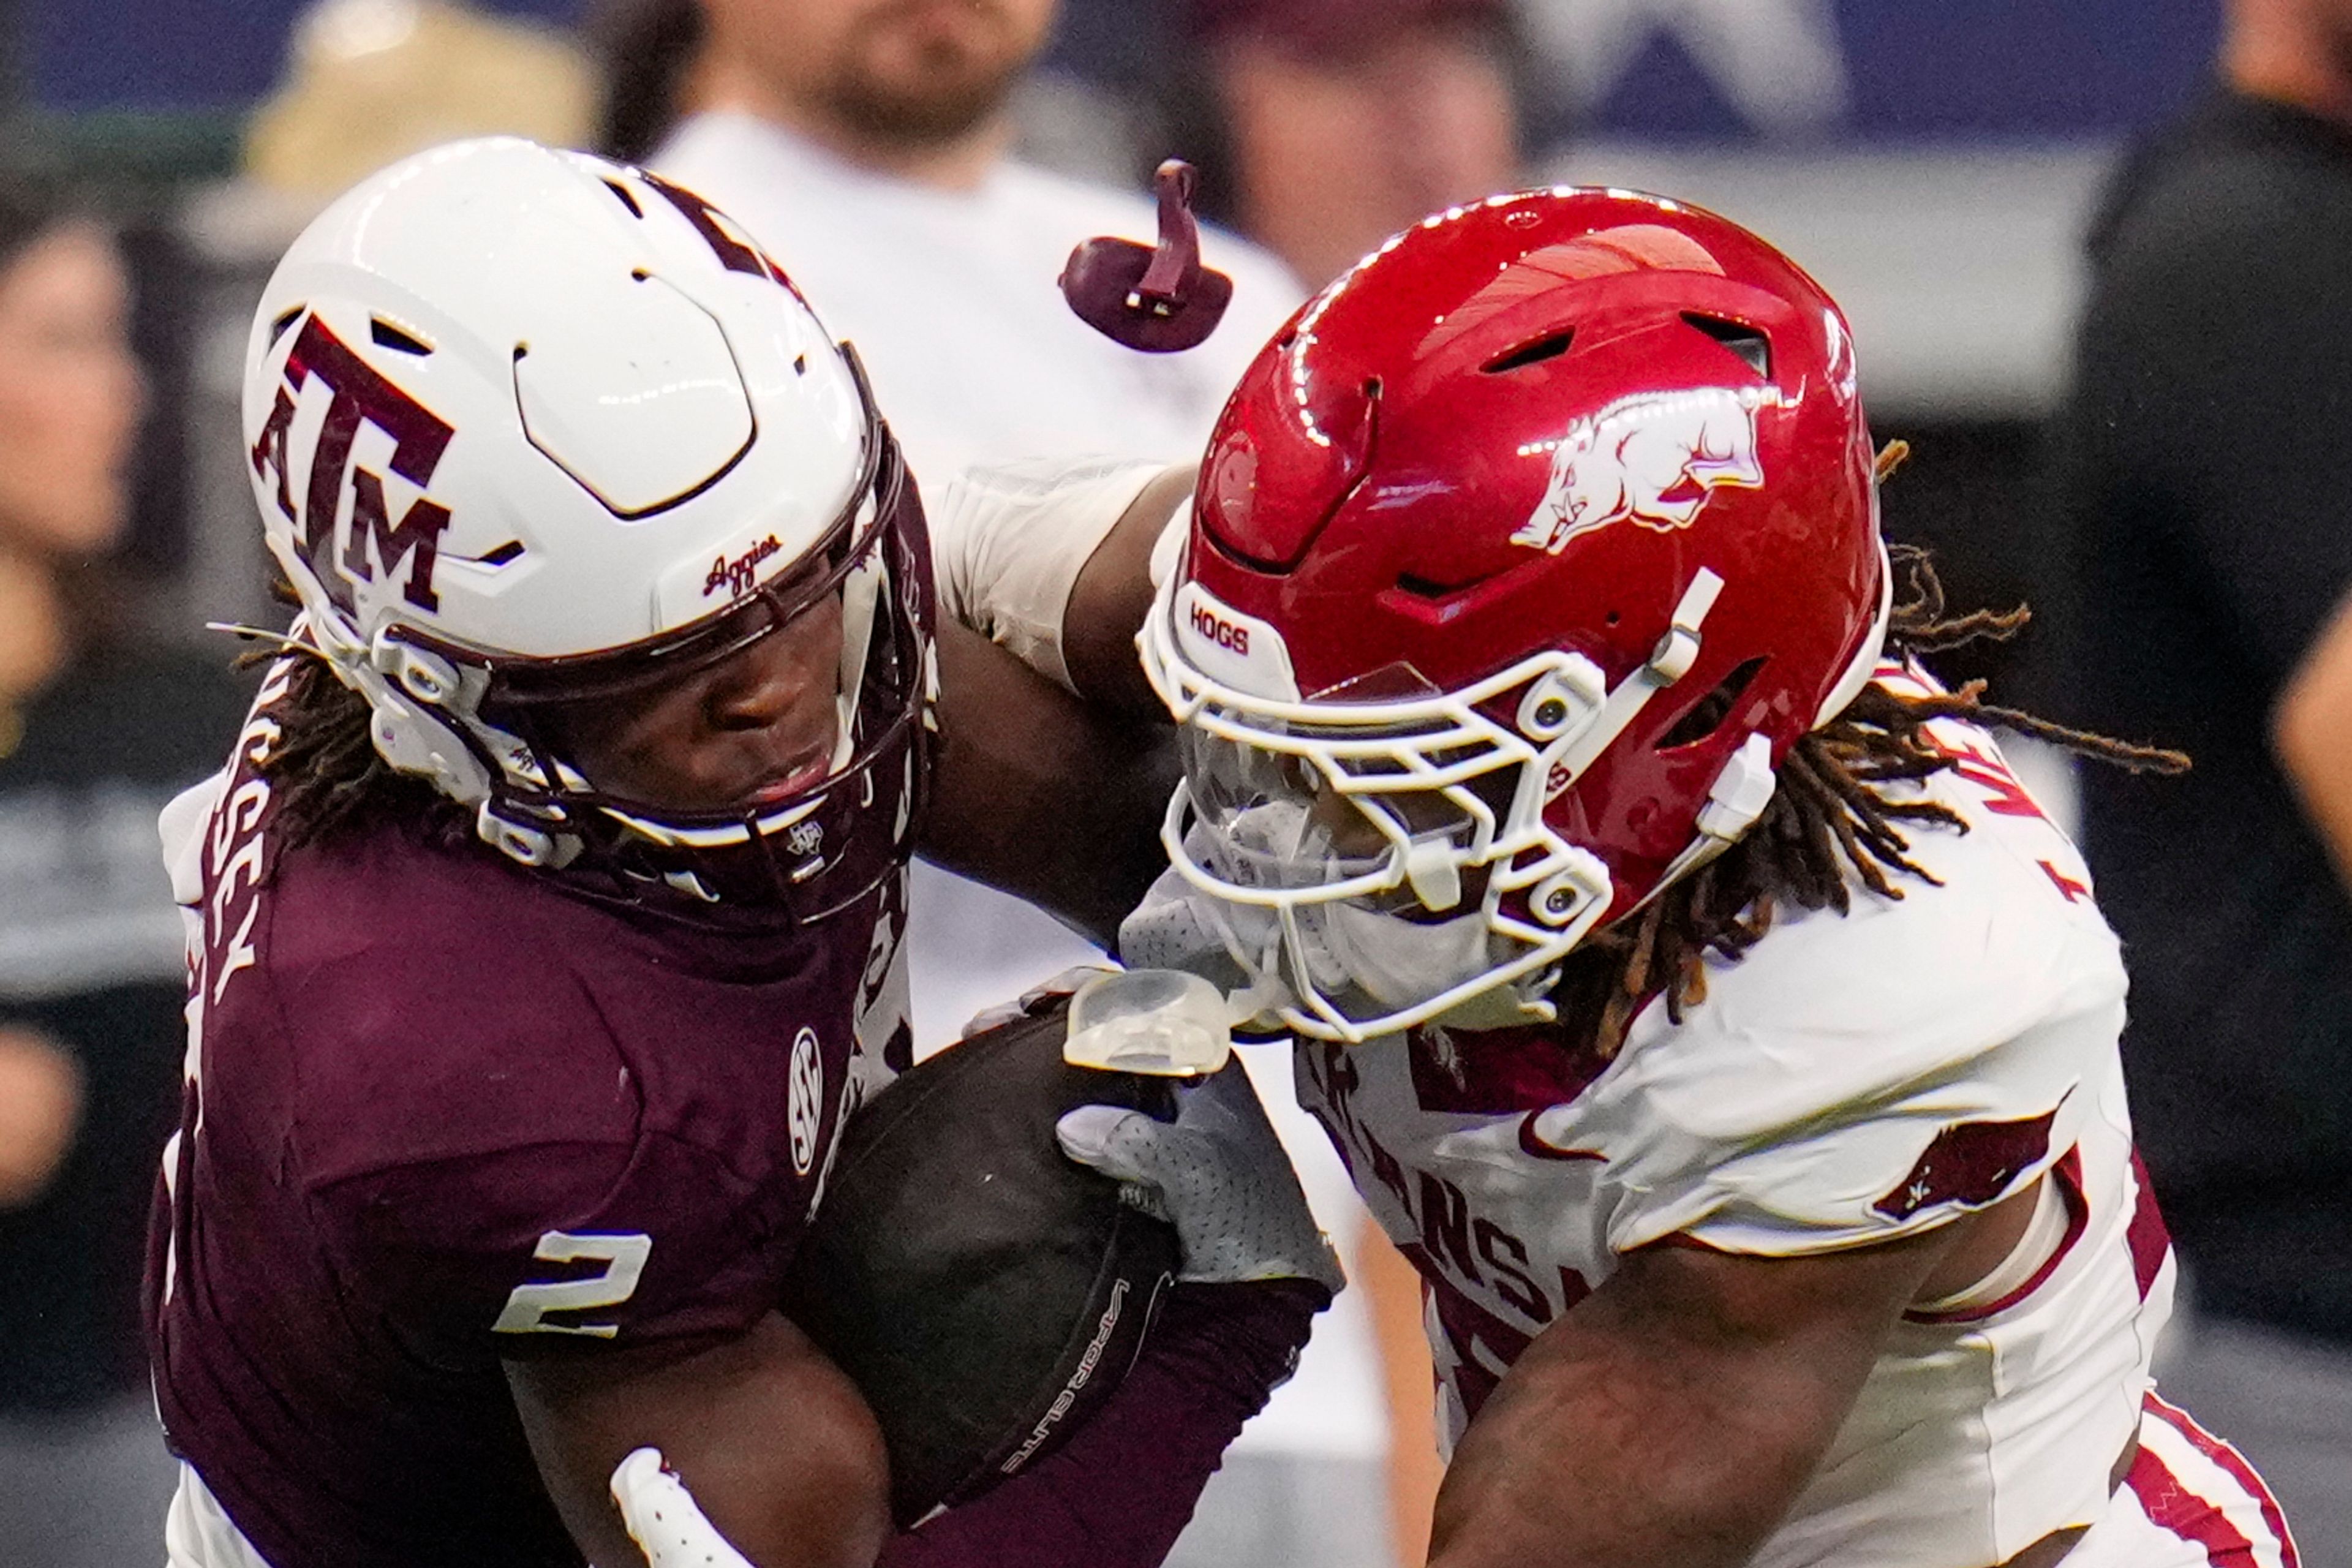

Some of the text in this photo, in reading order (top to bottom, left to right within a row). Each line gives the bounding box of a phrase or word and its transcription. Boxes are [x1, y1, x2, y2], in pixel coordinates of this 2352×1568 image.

[703, 533, 783, 598] Aggies
[1190, 600, 1249, 657] HOGS
[491, 1229, 652, 1340] 2
[1000, 1278, 1131, 1473] VAPOR ELITE
